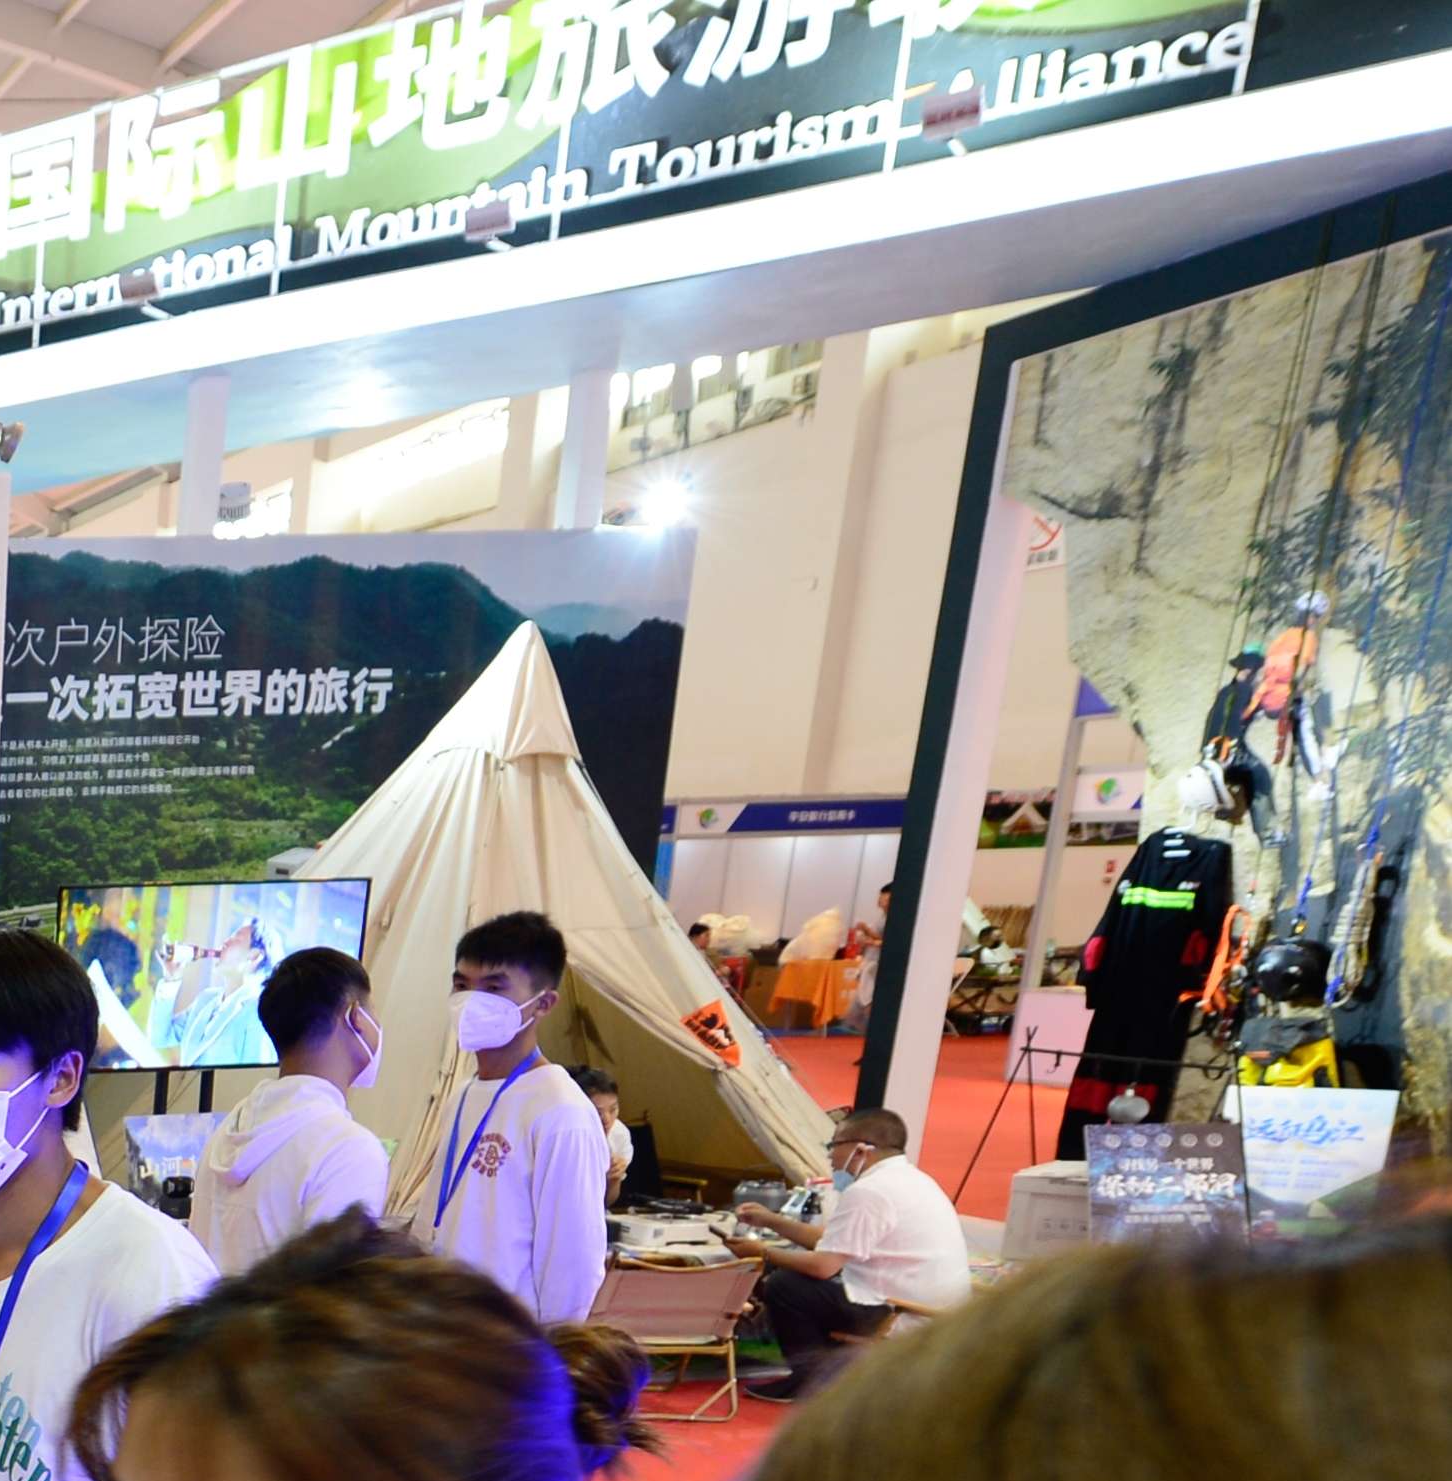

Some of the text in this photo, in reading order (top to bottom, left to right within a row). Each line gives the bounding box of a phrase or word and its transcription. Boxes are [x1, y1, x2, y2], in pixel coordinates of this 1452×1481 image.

[608, 96, 897, 196] Tourism
[4, 614, 225, 667] 次户外探险
[6, 667, 394, 723] 一次拓宽世界的旅行
